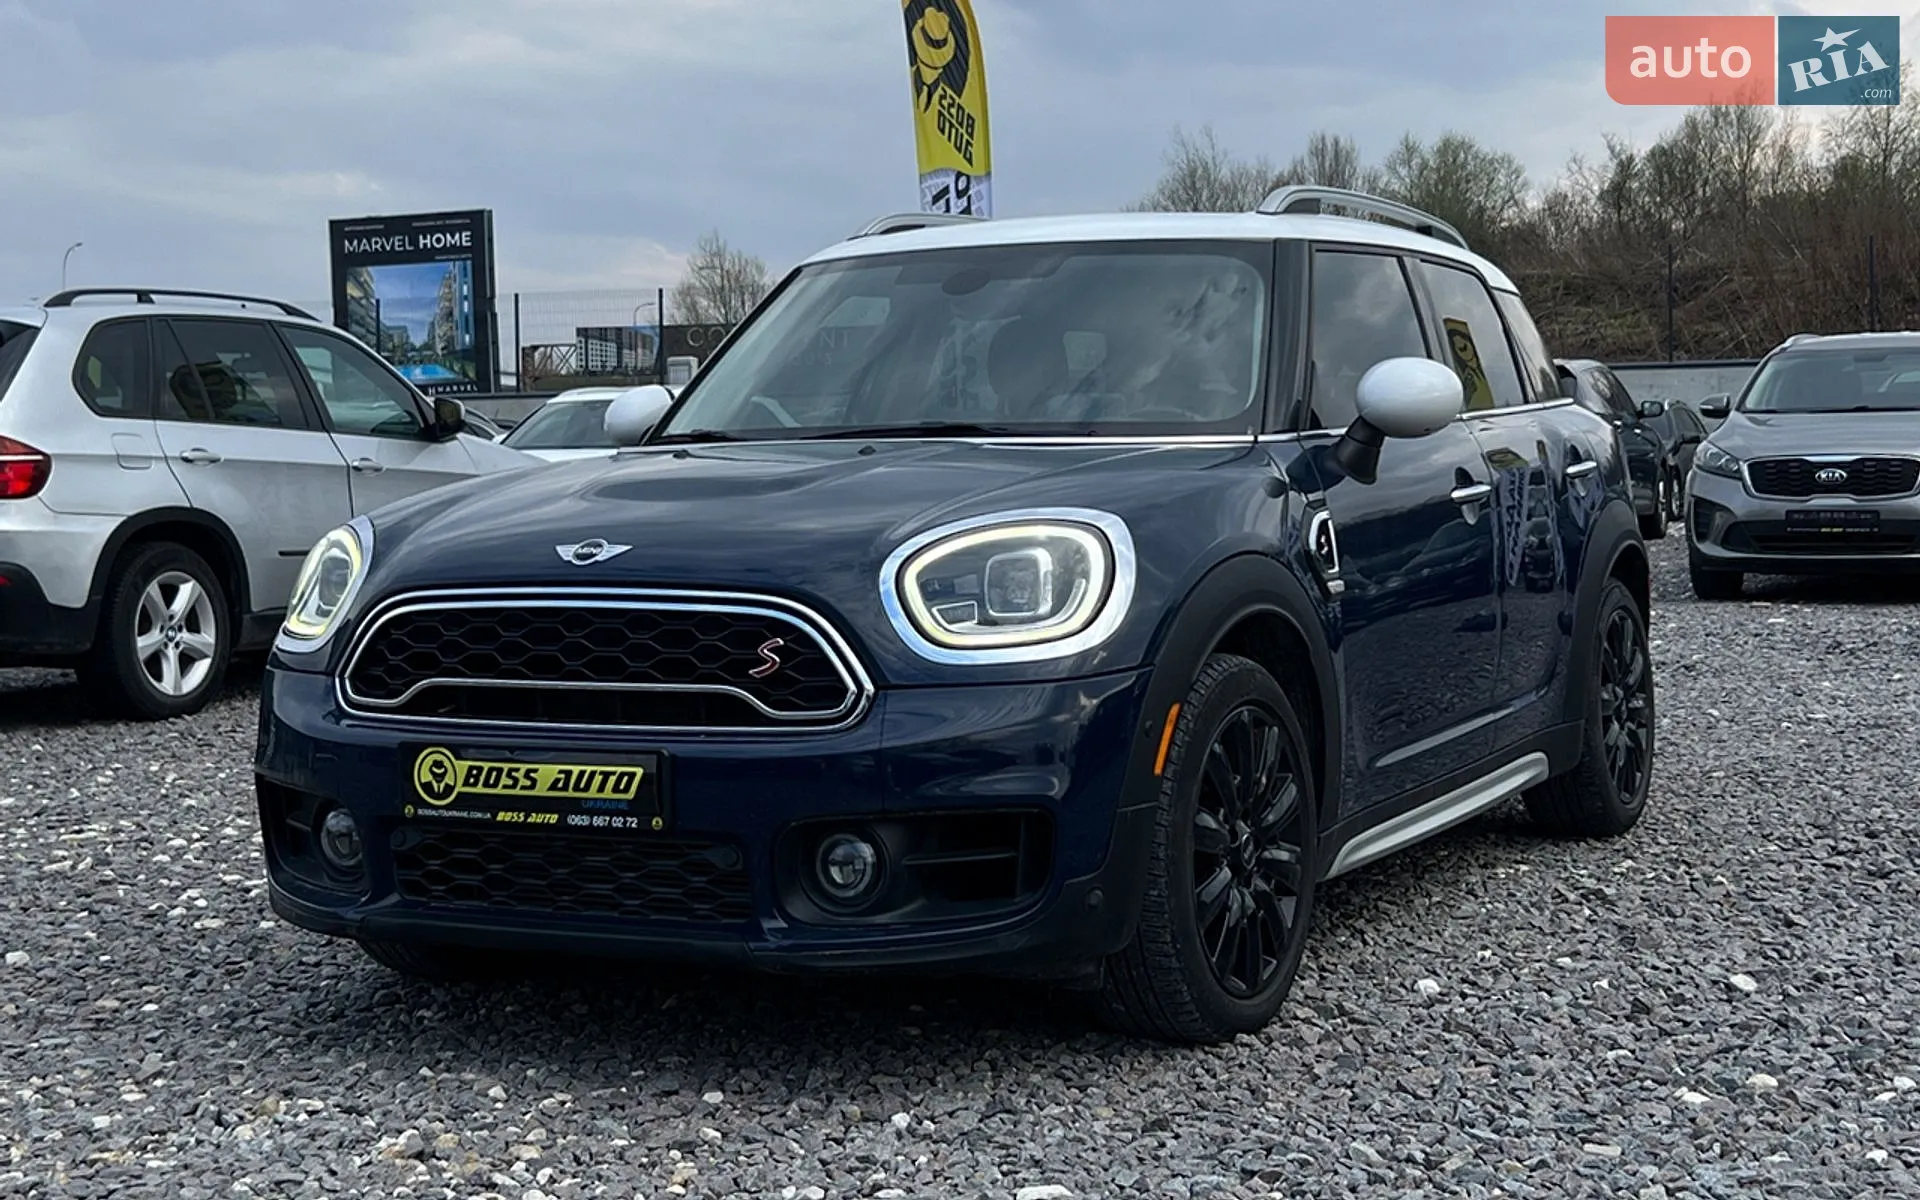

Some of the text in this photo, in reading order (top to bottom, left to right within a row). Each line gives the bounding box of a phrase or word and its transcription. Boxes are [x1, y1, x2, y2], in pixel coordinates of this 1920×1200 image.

[344, 231, 473, 254] MARVEL HOME
[437, 384, 478, 393] MARVEL
[747, 637, 785, 679] S
[462, 764, 636, 795] BOSS AUTO
[581, 799, 629, 810] UKRAINE
[496, 811, 525, 823] BOSS
[527, 812, 560, 824] AUTO
[611, 817, 624, 828] 02
[626, 817, 638, 829] 72
